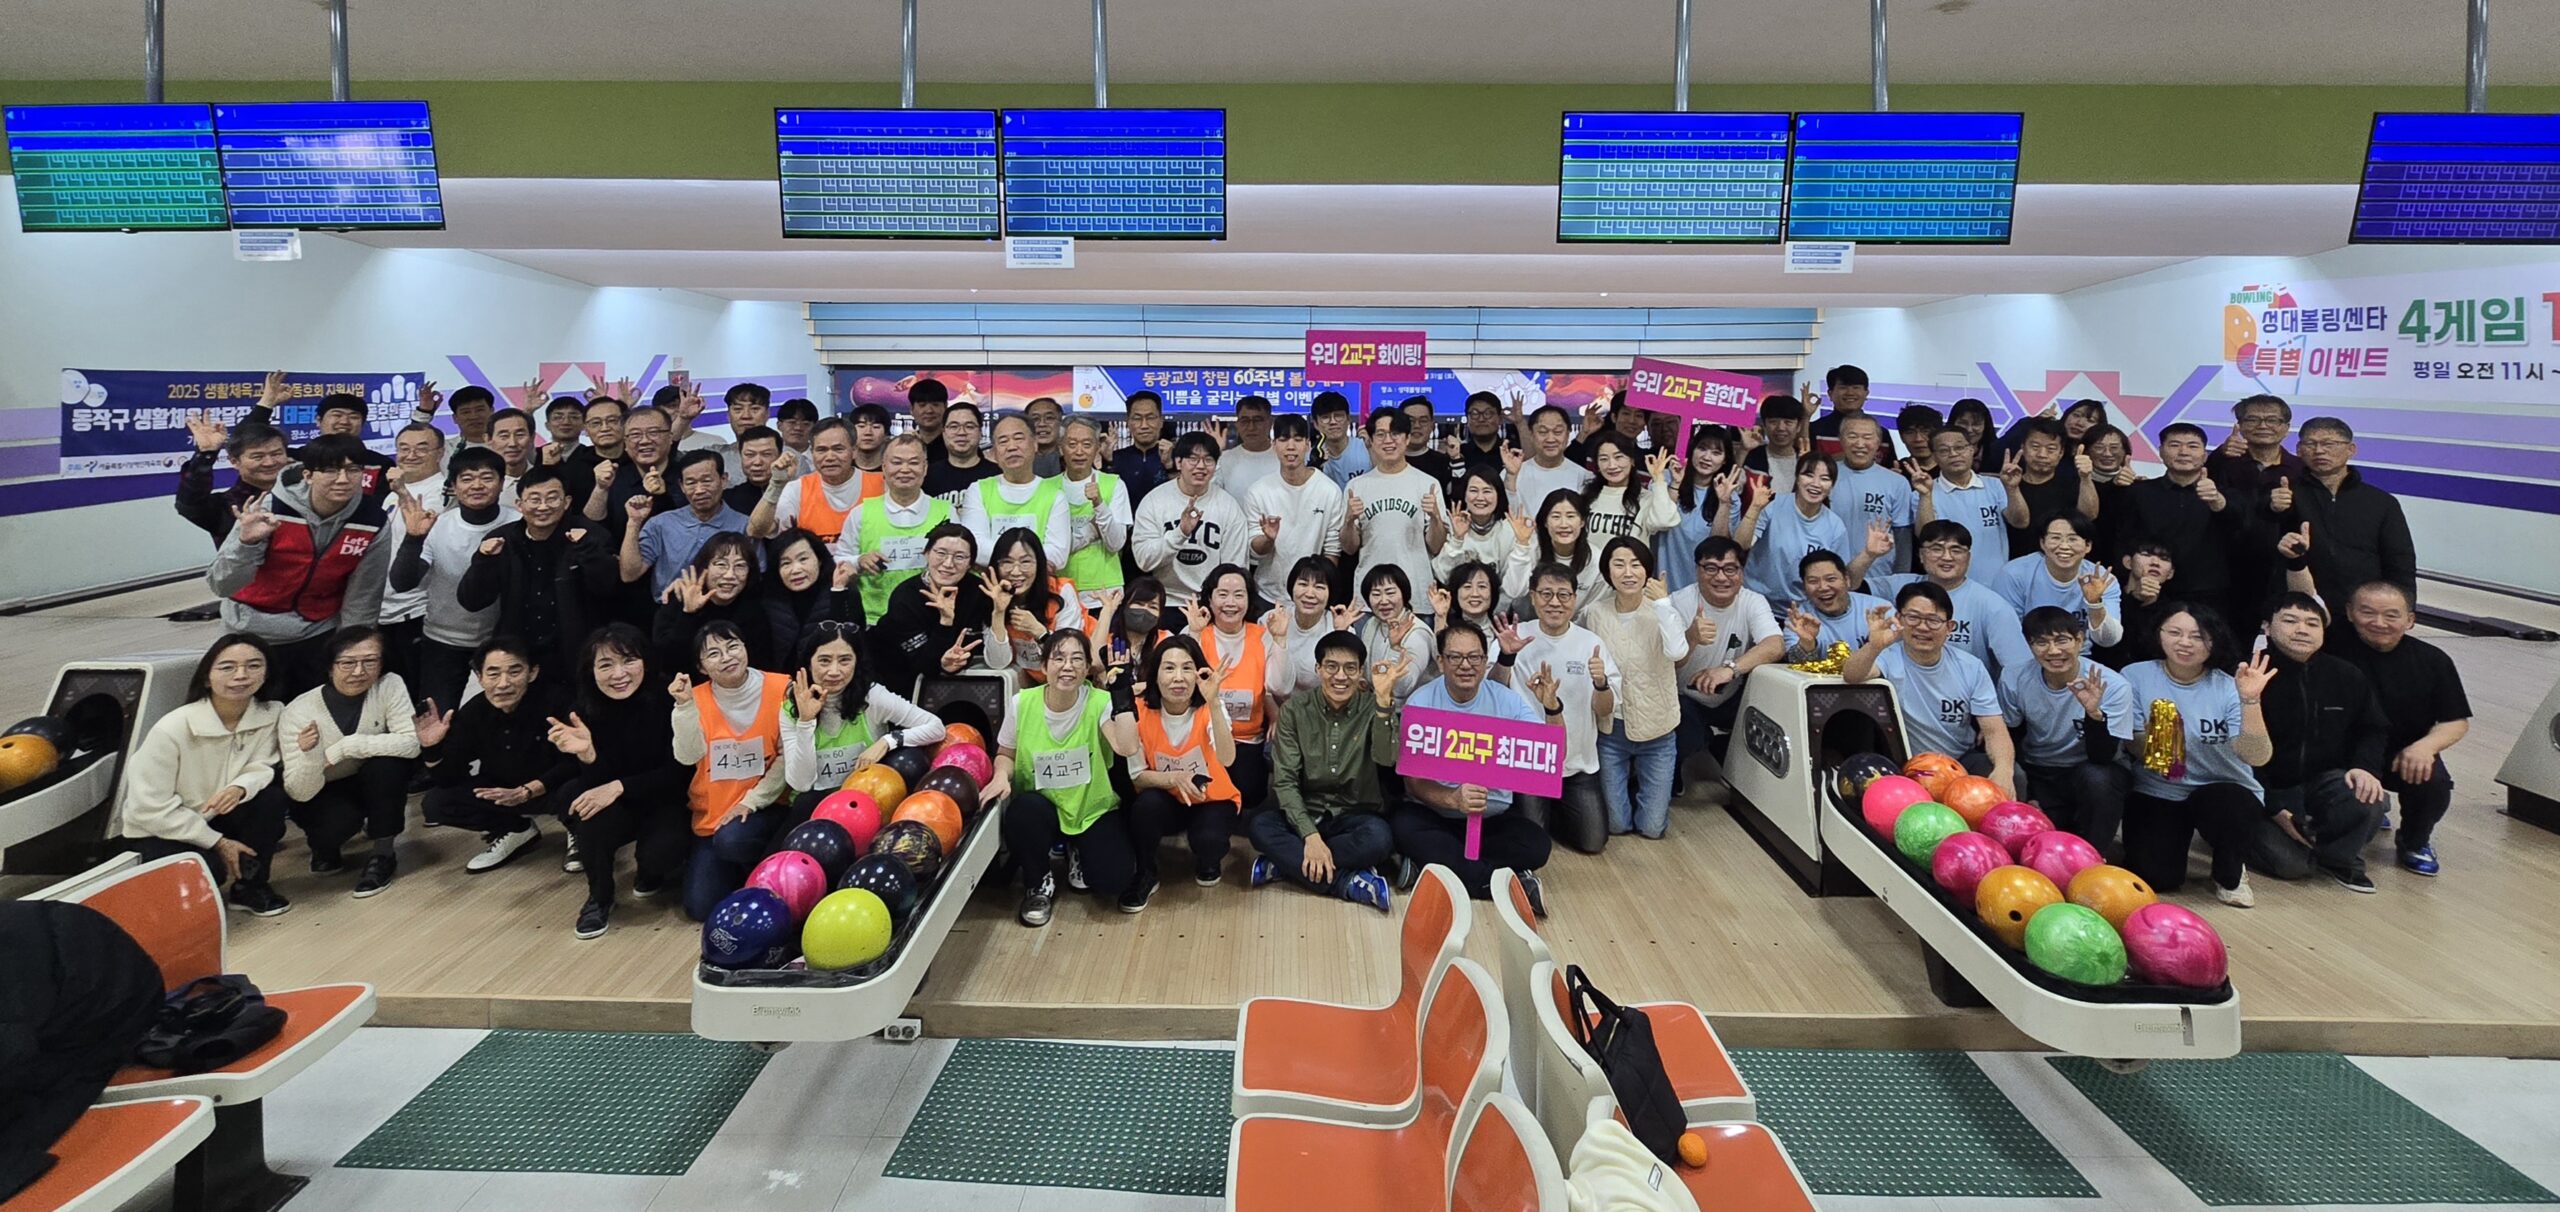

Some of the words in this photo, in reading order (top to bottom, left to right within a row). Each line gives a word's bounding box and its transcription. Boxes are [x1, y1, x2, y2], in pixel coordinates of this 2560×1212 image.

[2230, 291, 2272, 304] BOWLING
[2262, 306, 2388, 333] 성대볼링센타
[2398, 297, 2525, 343] 4게임
[1310, 342, 1337, 366] 우리
[1340, 343, 1376, 366] 2교구
[1378, 343, 1422, 366] 화이팅!
[2255, 347, 2301, 376] 특별
[2308, 347, 2389, 377] 이벤트
[1142, 371, 1198, 387] 동광교회
[1202, 371, 1230, 387] 창립
[1233, 369, 1285, 387] 60주년
[2413, 361, 2450, 379] 평일
[2457, 362, 2494, 379] 오전
[2501, 361, 2544, 380] 11시
[168, 384, 200, 399] 2025
[1162, 390, 1202, 405] 기쁨을
[1632, 370, 1662, 395] 우리
[1662, 375, 1703, 402] 2교구
[1703, 382, 1757, 410] 잘한다~
[72, 408, 130, 432] 동작구
[361, 481, 372, 489] K
[1865, 492, 1885, 506] DK
[1364, 498, 1418, 520] DAVIDSON
[1980, 506, 1999, 520] DK
[344, 535, 370, 547] Let's
[339, 544, 366, 557] DK
[1941, 698, 1966, 714] DK
[2199, 718, 2228, 735] DK
[1406, 723, 1442, 757] 우리
[1444, 729, 1494, 764] 2교구
[1496, 735, 1557, 774] 최고다!
